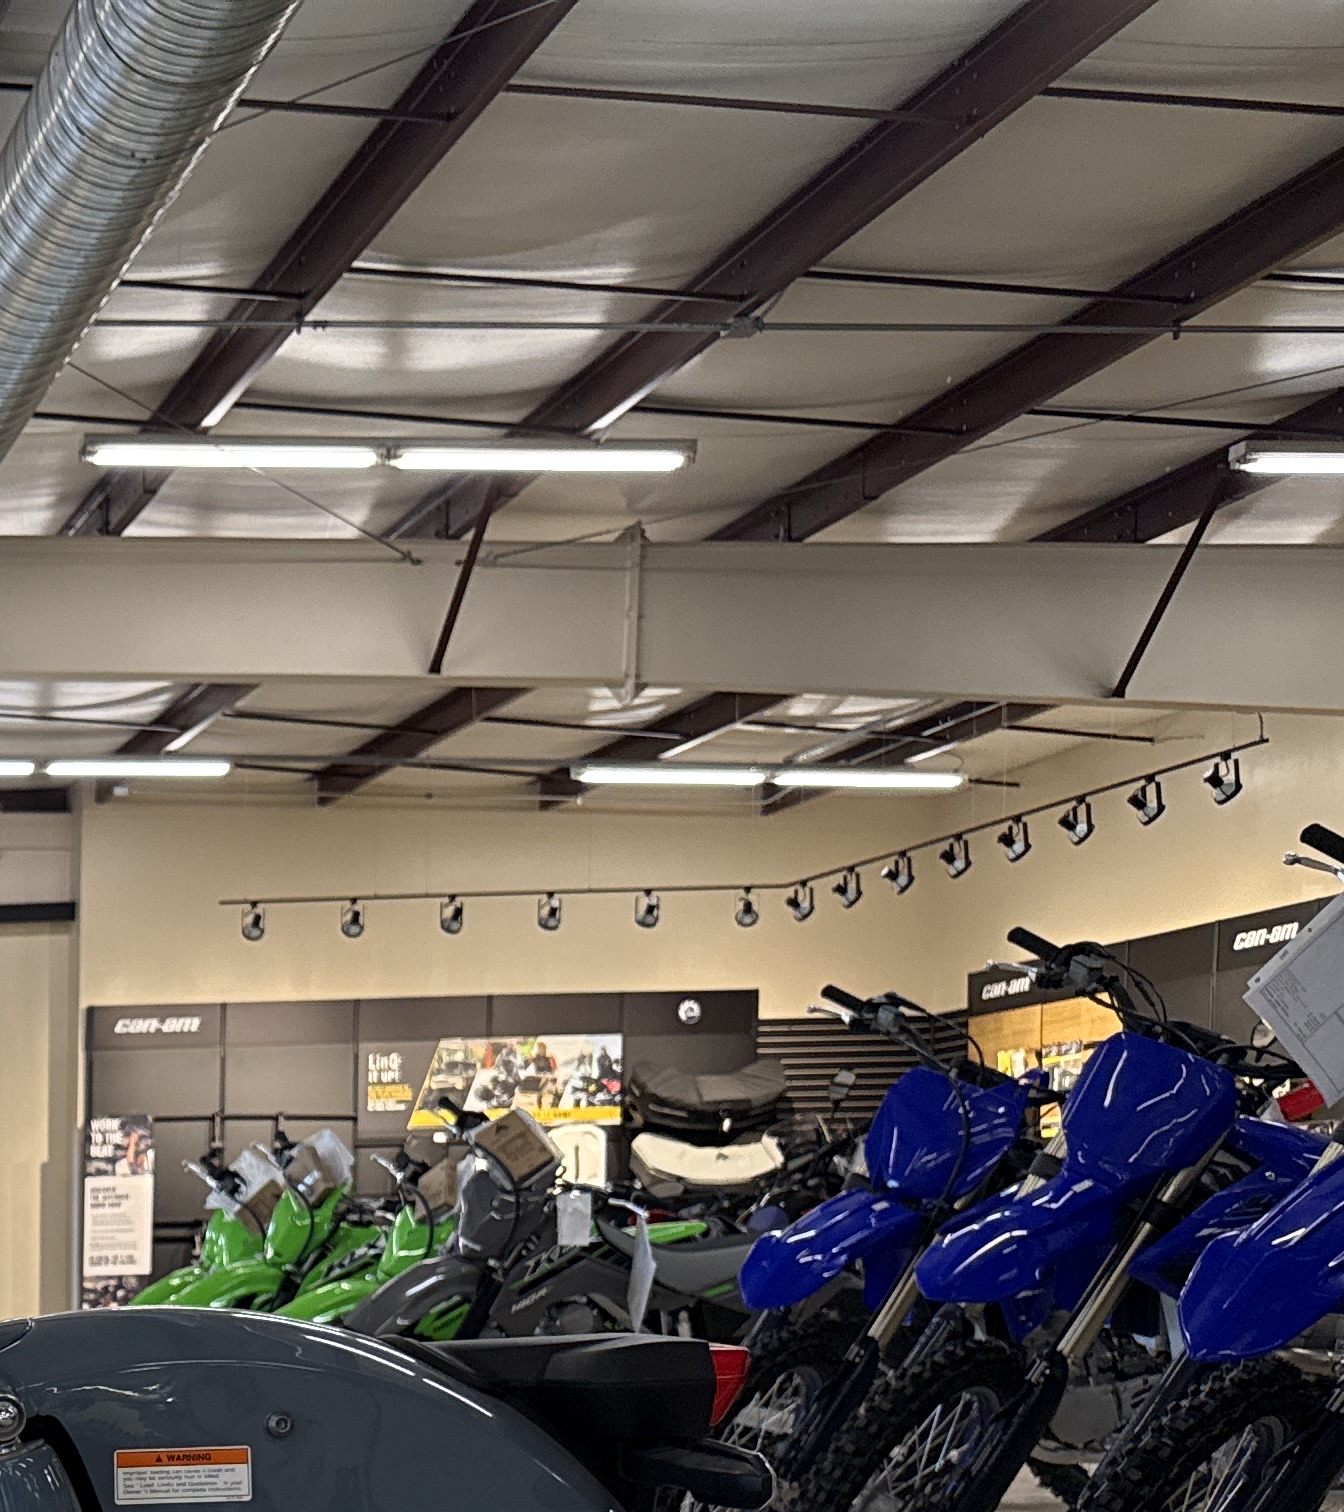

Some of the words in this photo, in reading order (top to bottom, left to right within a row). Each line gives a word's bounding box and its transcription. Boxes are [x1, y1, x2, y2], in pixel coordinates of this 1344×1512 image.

[1233, 922, 1299, 951] can-am
[981, 976, 1031, 1000] can-am
[114, 1016, 202, 1034] can-am
[166, 1453, 212, 1463] WARNING
